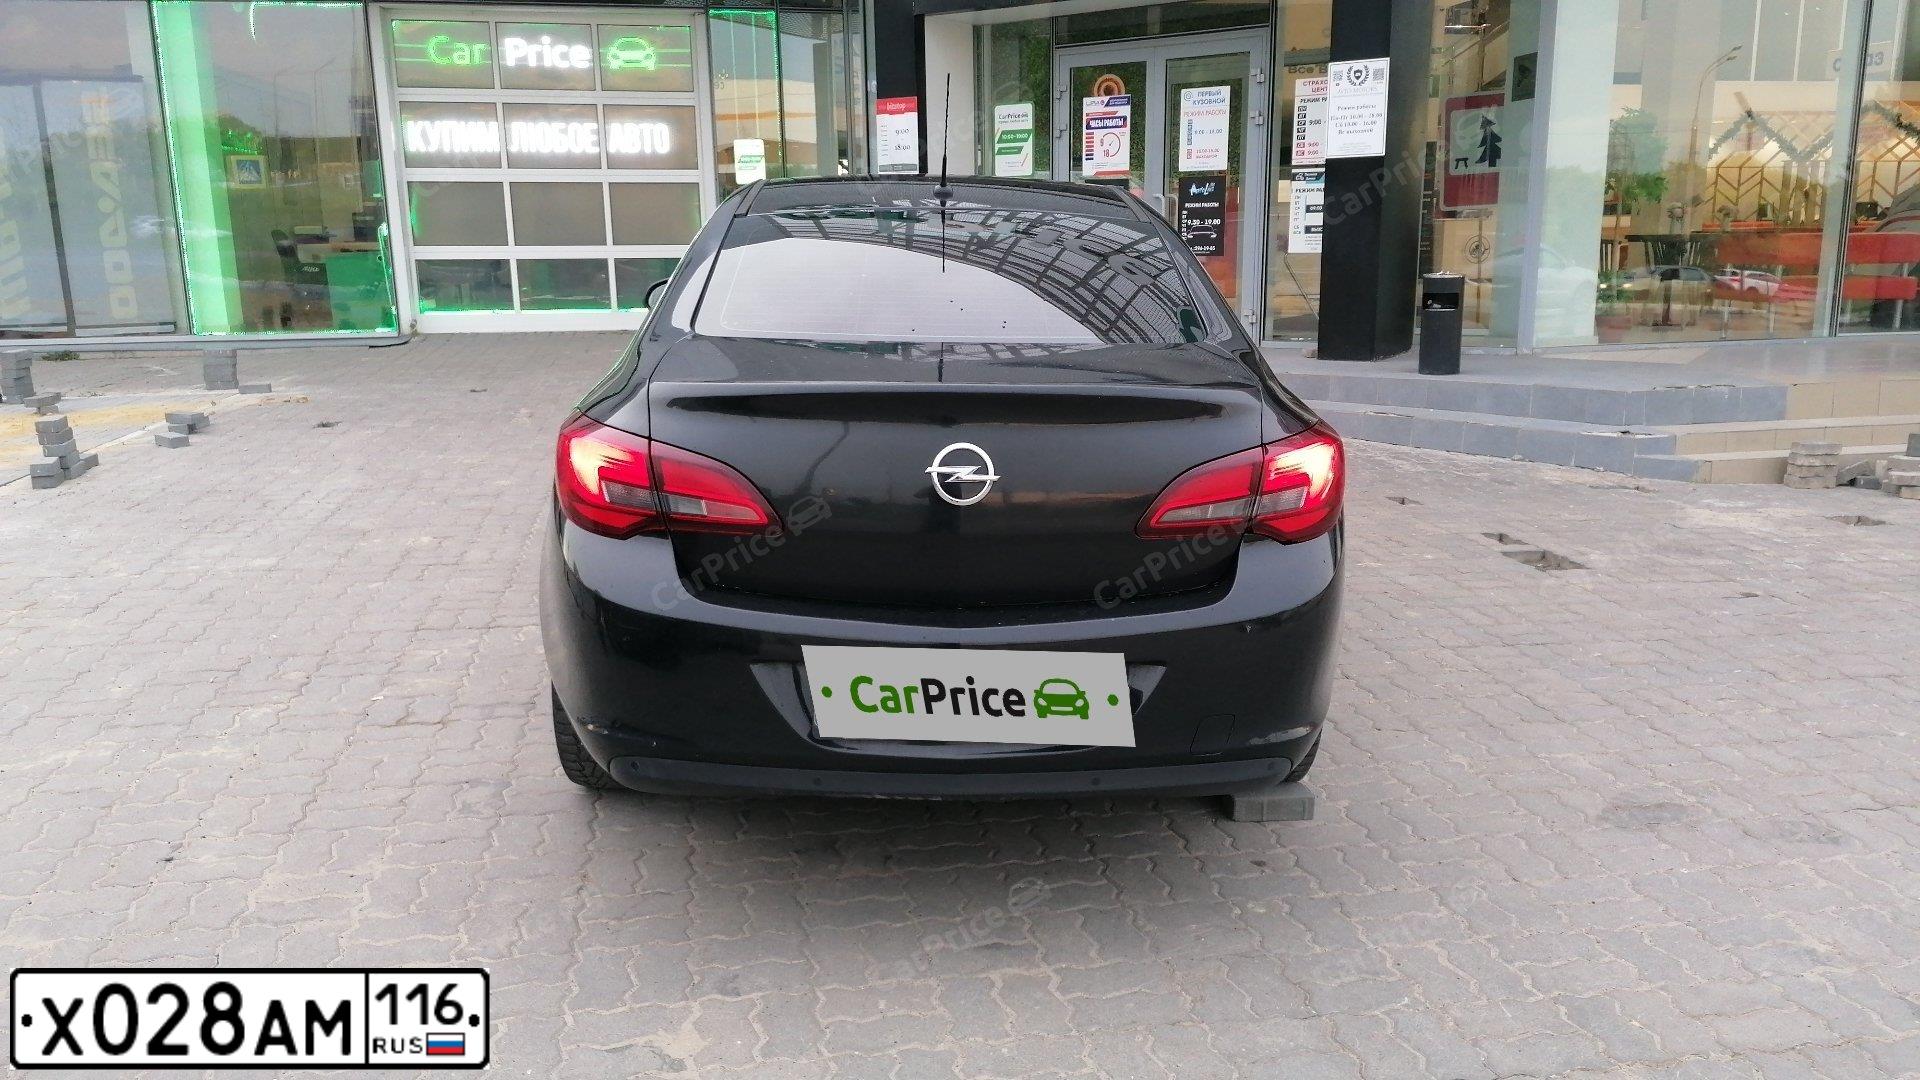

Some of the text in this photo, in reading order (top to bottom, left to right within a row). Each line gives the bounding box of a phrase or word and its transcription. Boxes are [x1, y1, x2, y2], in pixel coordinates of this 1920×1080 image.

[427, 35, 593, 70] Car Price
[1197, 89, 1222, 98] ПЕРВЫЙ
[1192, 97, 1226, 106] КУЗОВНОЙ
[1089, 118, 1124, 128] ЧАСЫ РАБОТЫ
[406, 120, 671, 155] КУПИМ ЛЮБОЕ АВТО
